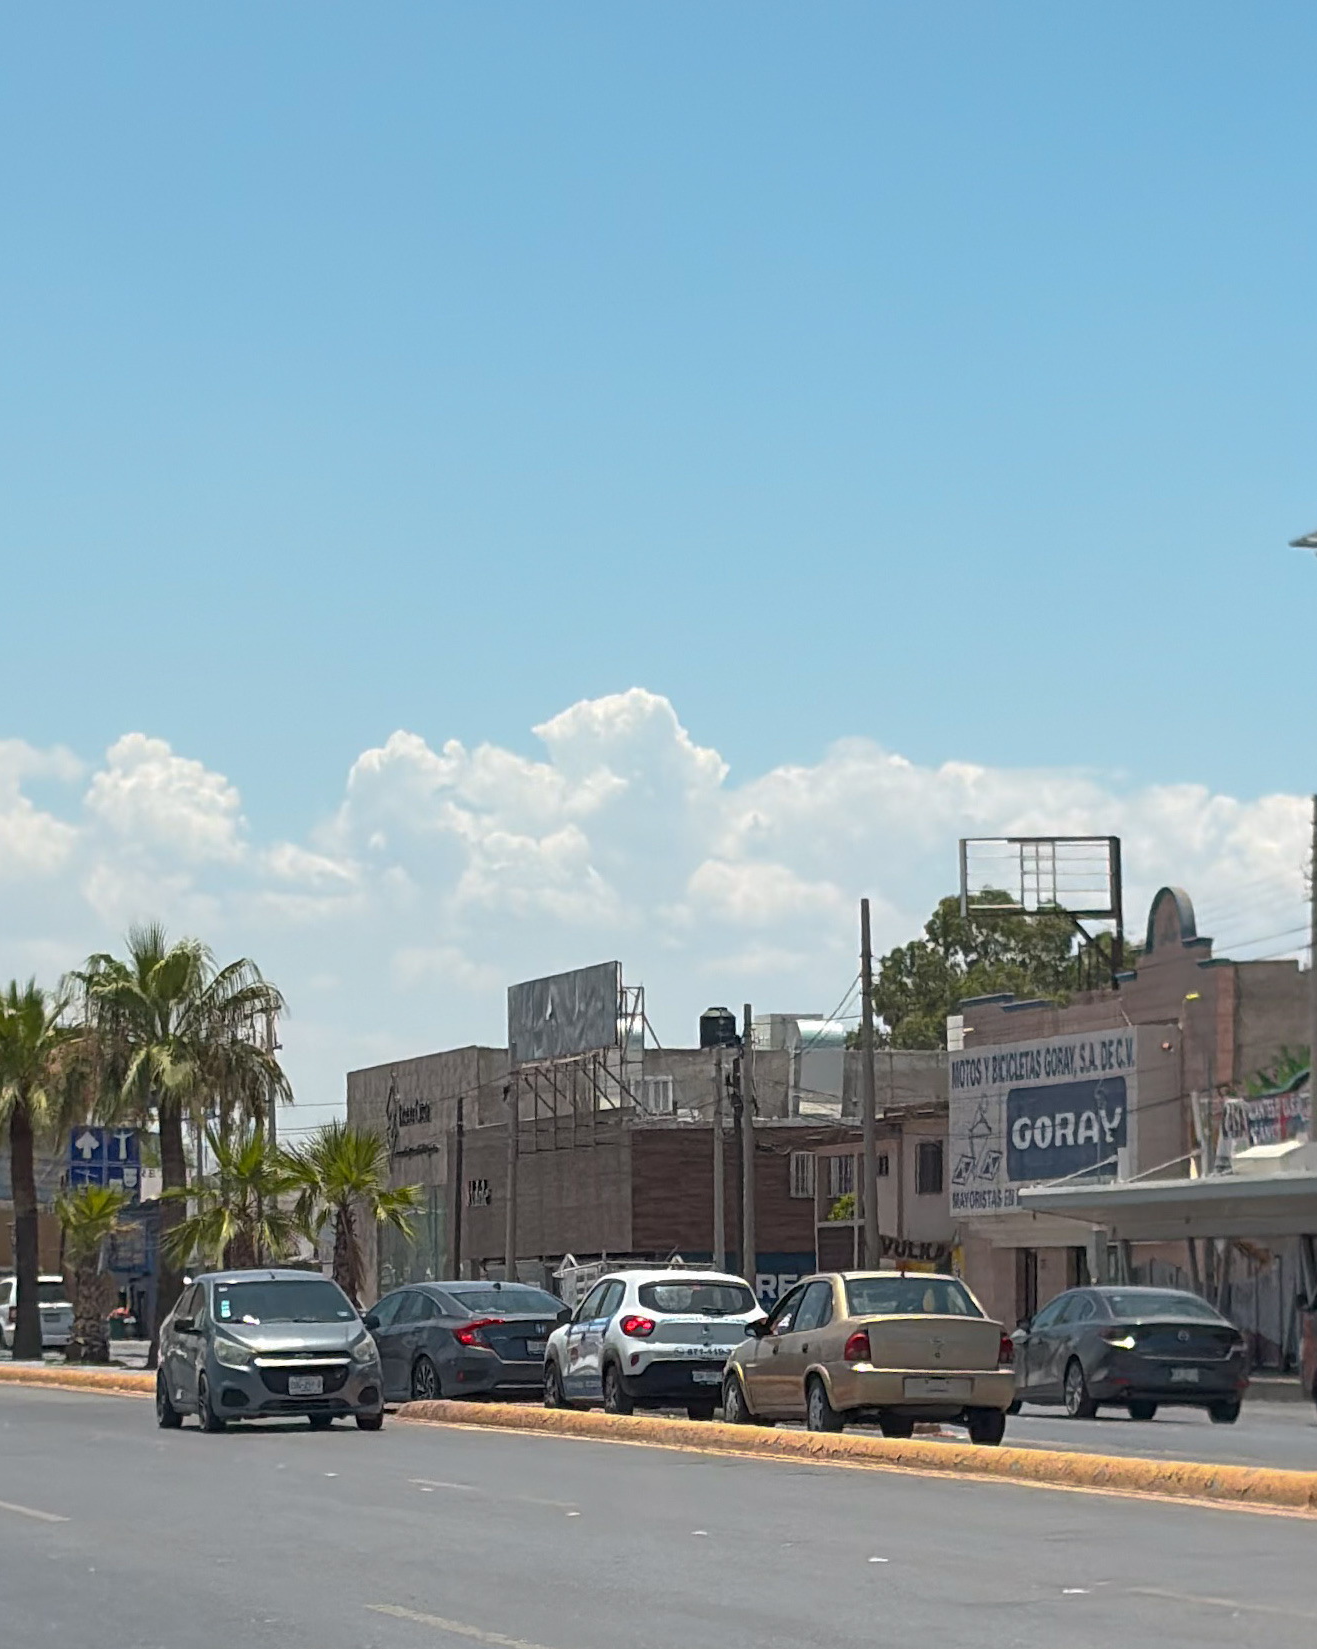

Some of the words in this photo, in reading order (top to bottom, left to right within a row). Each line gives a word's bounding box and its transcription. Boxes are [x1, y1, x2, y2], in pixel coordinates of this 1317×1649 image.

[951, 1058, 982, 1090] MOTOS
[991, 1049, 1042, 1084] BICICLETAS
[1100, 1039, 1114, 1071] DE
[1011, 1105, 1123, 1150] GORAY
[951, 1188, 1003, 1210] MAYORISTAS
